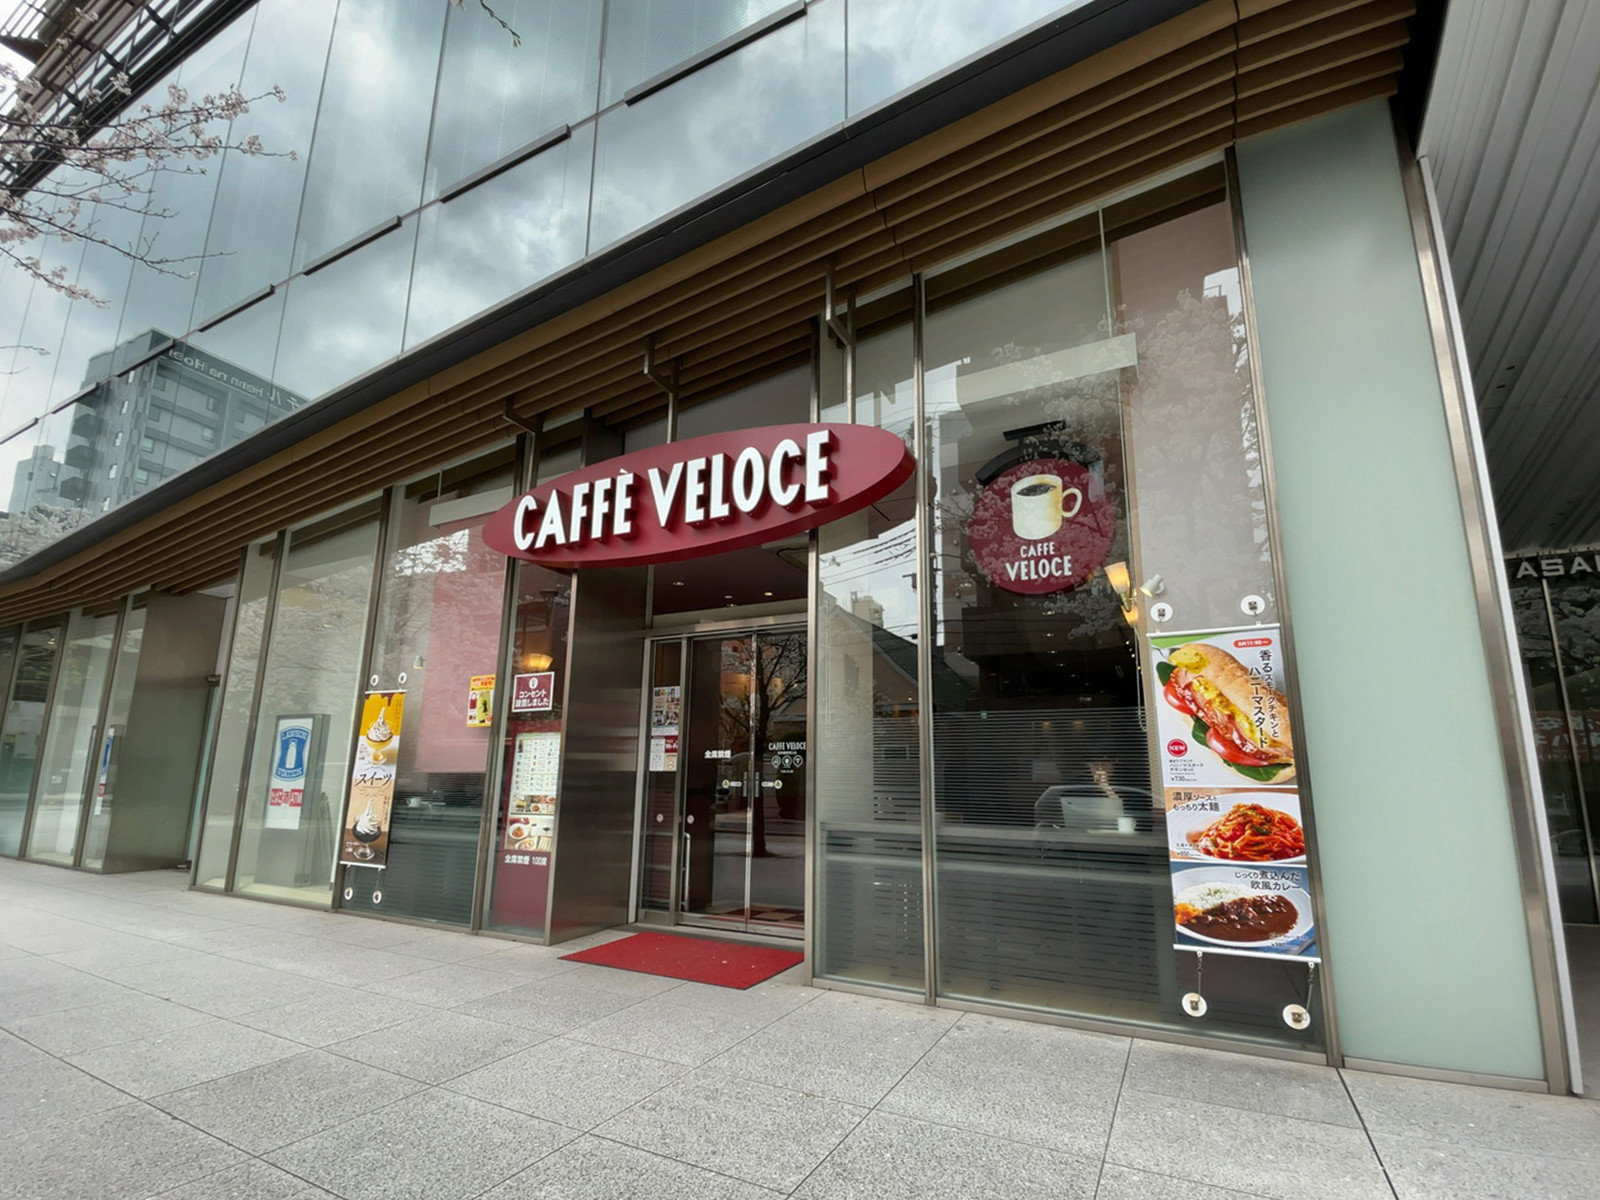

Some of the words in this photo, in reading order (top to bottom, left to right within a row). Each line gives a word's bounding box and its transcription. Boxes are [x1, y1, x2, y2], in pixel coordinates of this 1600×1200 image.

[513, 468, 635, 551] CAFFÈ
[647, 429, 831, 528] VELOCE
[1005, 555, 1073, 582] VELOCE
[1516, 553, 1600, 579] ASA
[519, 689, 547, 698] コンセント
[1249, 667, 1268, 749] ハニーマスタード
[355, 772, 392, 786] スイーツ
[1235, 870, 1301, 881] じっくり煮込んだ
[1250, 880, 1301, 891] 欧風カレー
